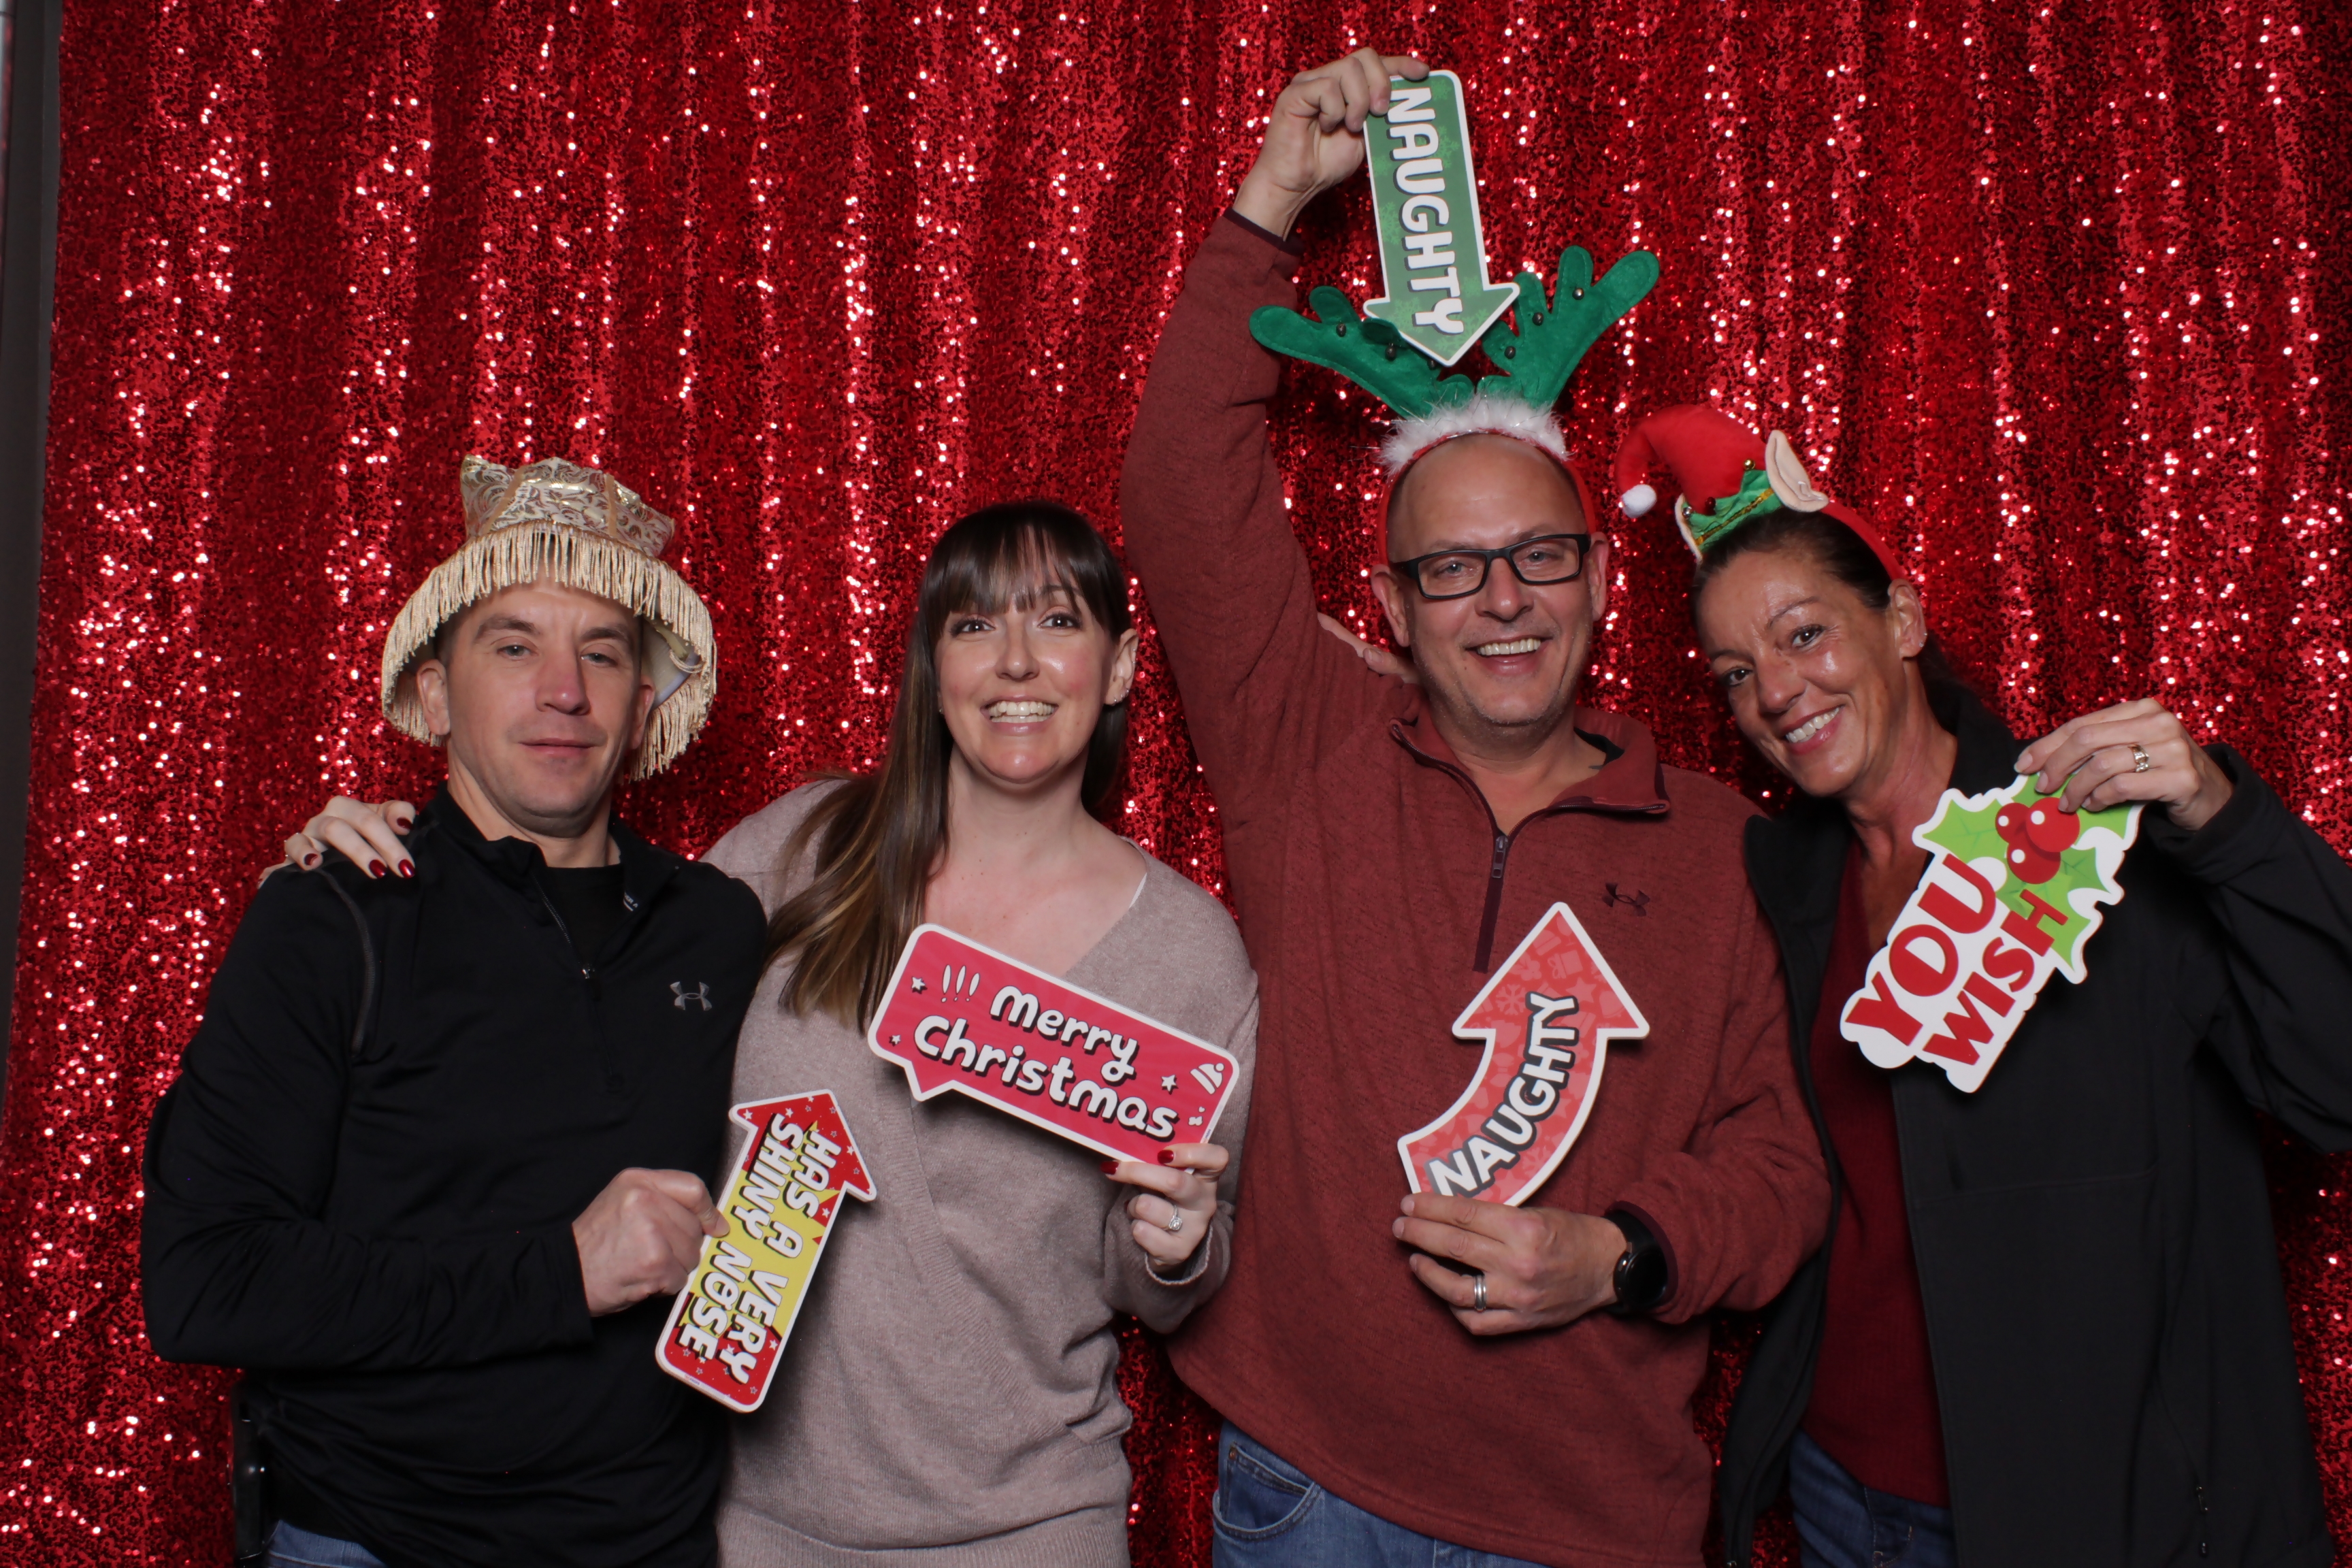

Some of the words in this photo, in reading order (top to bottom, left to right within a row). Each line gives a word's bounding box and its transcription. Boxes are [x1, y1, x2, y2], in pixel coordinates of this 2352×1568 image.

[1387, 87, 1465, 334] NAUGHTY
[1845, 853, 1996, 1047] YOU
[1923, 889, 2069, 1066] WISH
[913, 1015, 1180, 1139] Christmas
[990, 985, 1138, 1082] Merry
[1428, 992, 1575, 1196] NAUGHTY
[734, 1113, 804, 1240] SHINY
[783, 1129, 842, 1218] HAS
[679, 1241, 753, 1360] NOSE
[766, 1220, 804, 1258] A
[725, 1269, 789, 1384] VERY
